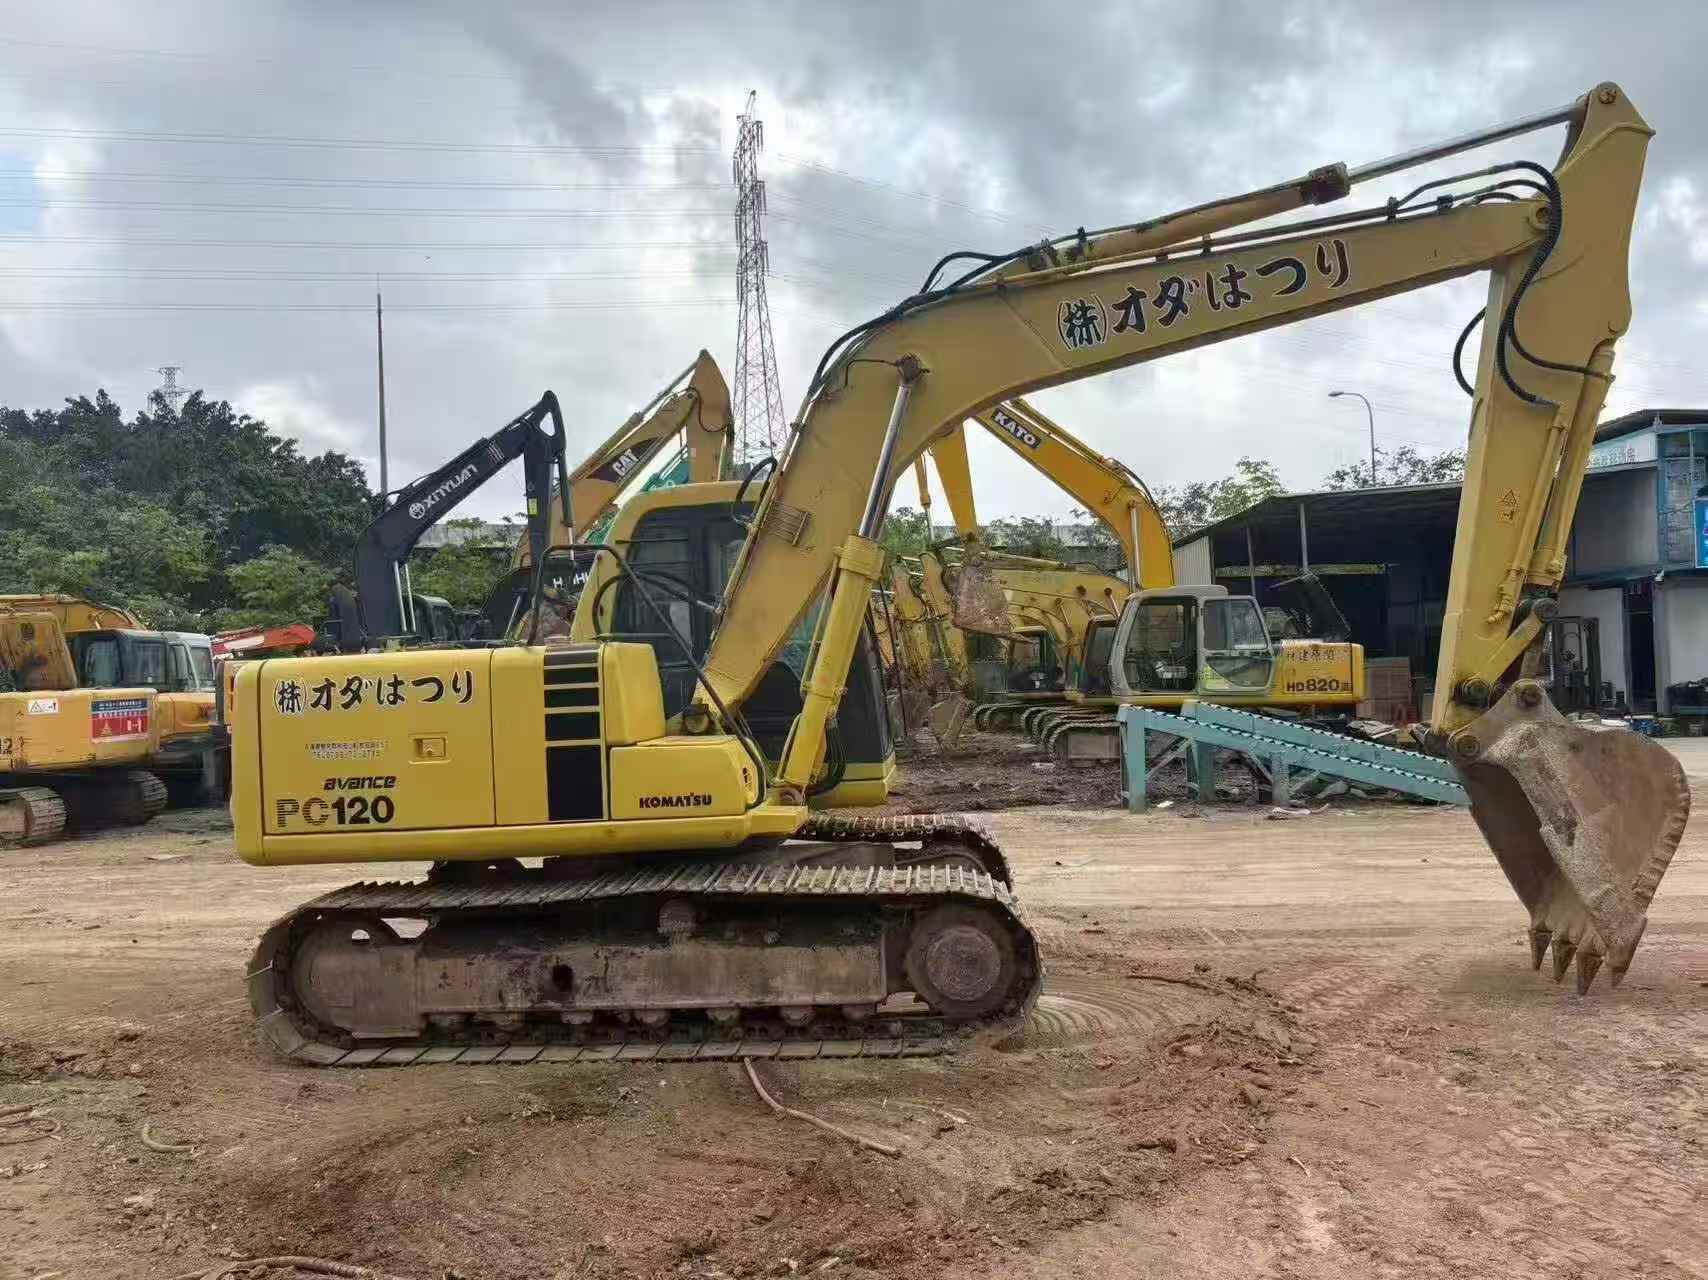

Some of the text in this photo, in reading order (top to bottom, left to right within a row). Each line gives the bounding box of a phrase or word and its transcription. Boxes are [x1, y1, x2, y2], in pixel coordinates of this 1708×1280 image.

[994, 410, 1037, 446] KATO
[612, 448, 640, 477] CAT
[1286, 678, 1340, 692] HD820
[323, 775, 396, 791] avance
[275, 795, 395, 828] PC120
[639, 793, 712, 809] KOMATSU
